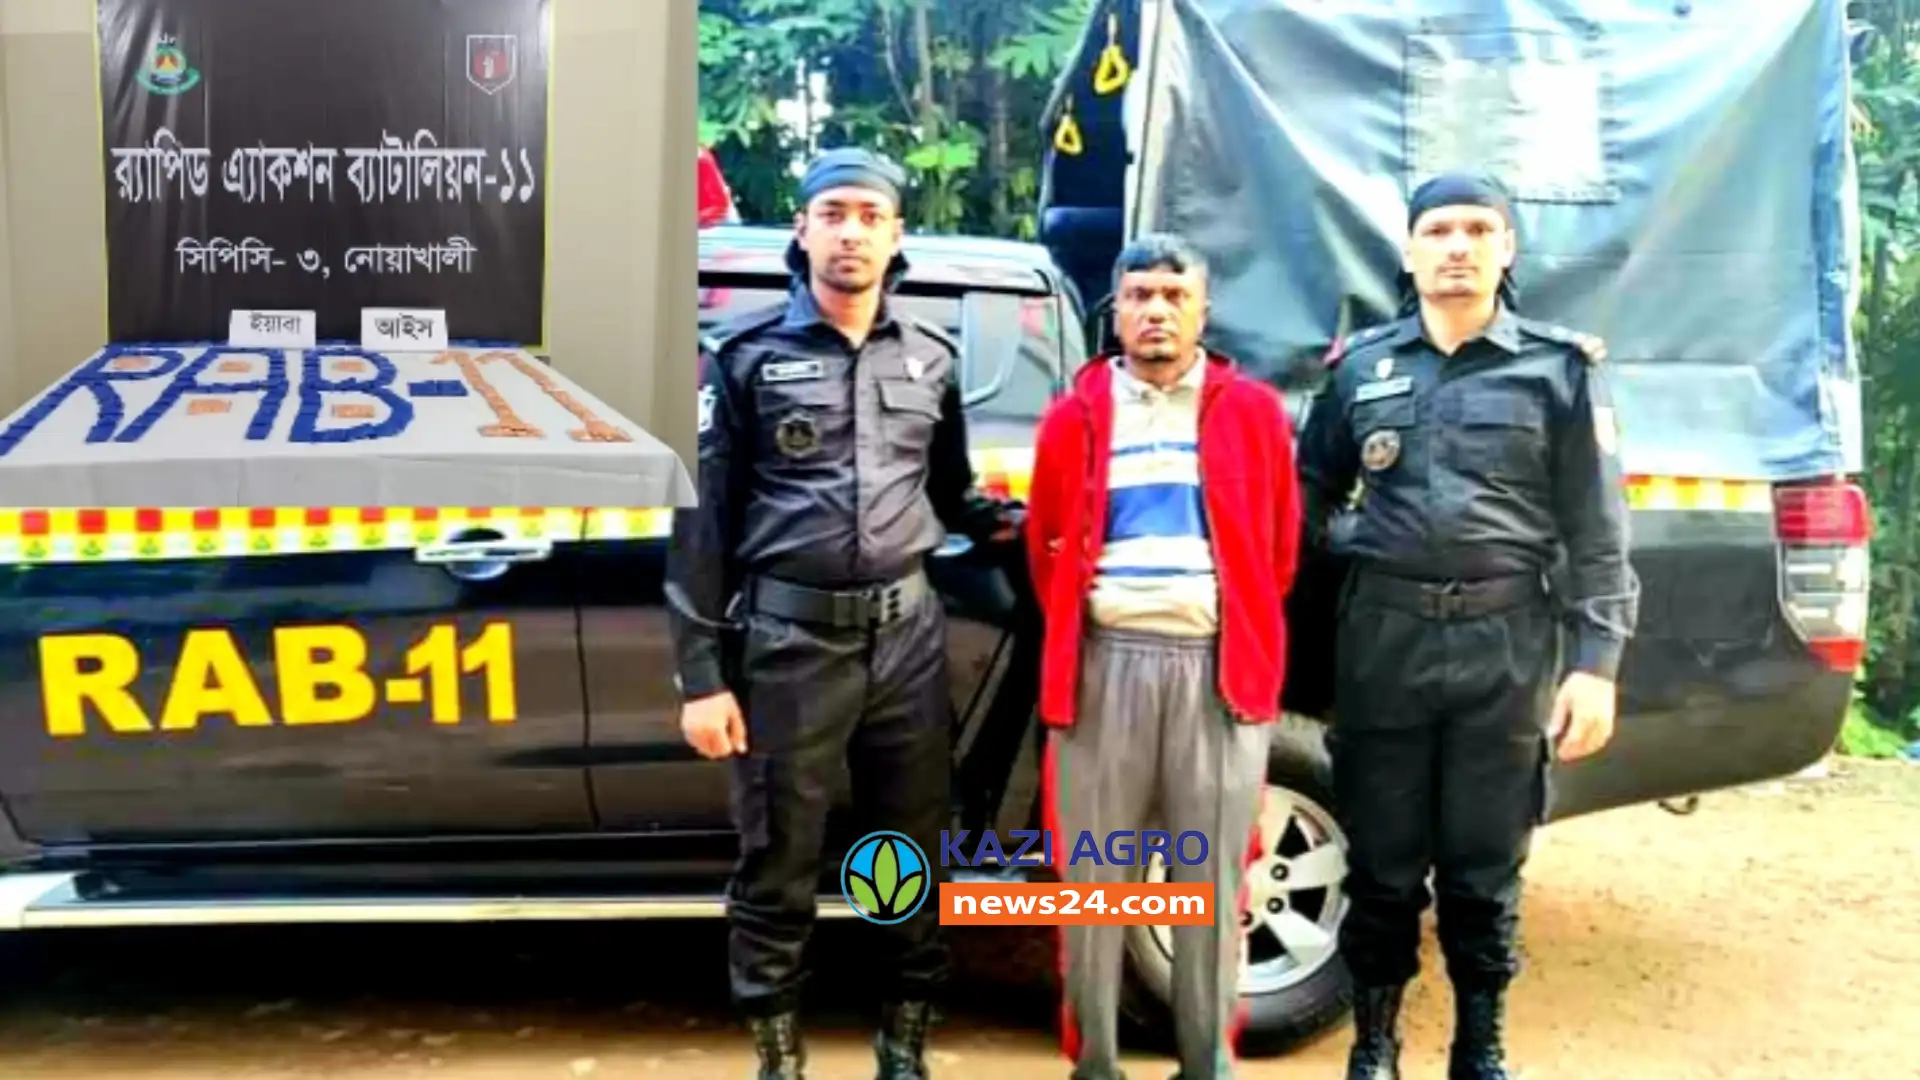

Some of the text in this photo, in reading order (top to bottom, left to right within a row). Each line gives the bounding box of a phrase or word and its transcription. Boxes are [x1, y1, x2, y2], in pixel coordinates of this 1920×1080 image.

[222, 139, 338, 203] এ্যাকশন
[344, 236, 478, 274] নোয়াখালী
[250, 312, 301, 335] ইয়াবা
[374, 312, 435, 340] আইস
[0, 345, 633, 456] RAB-11
[38, 622, 518, 737] RAB-11
